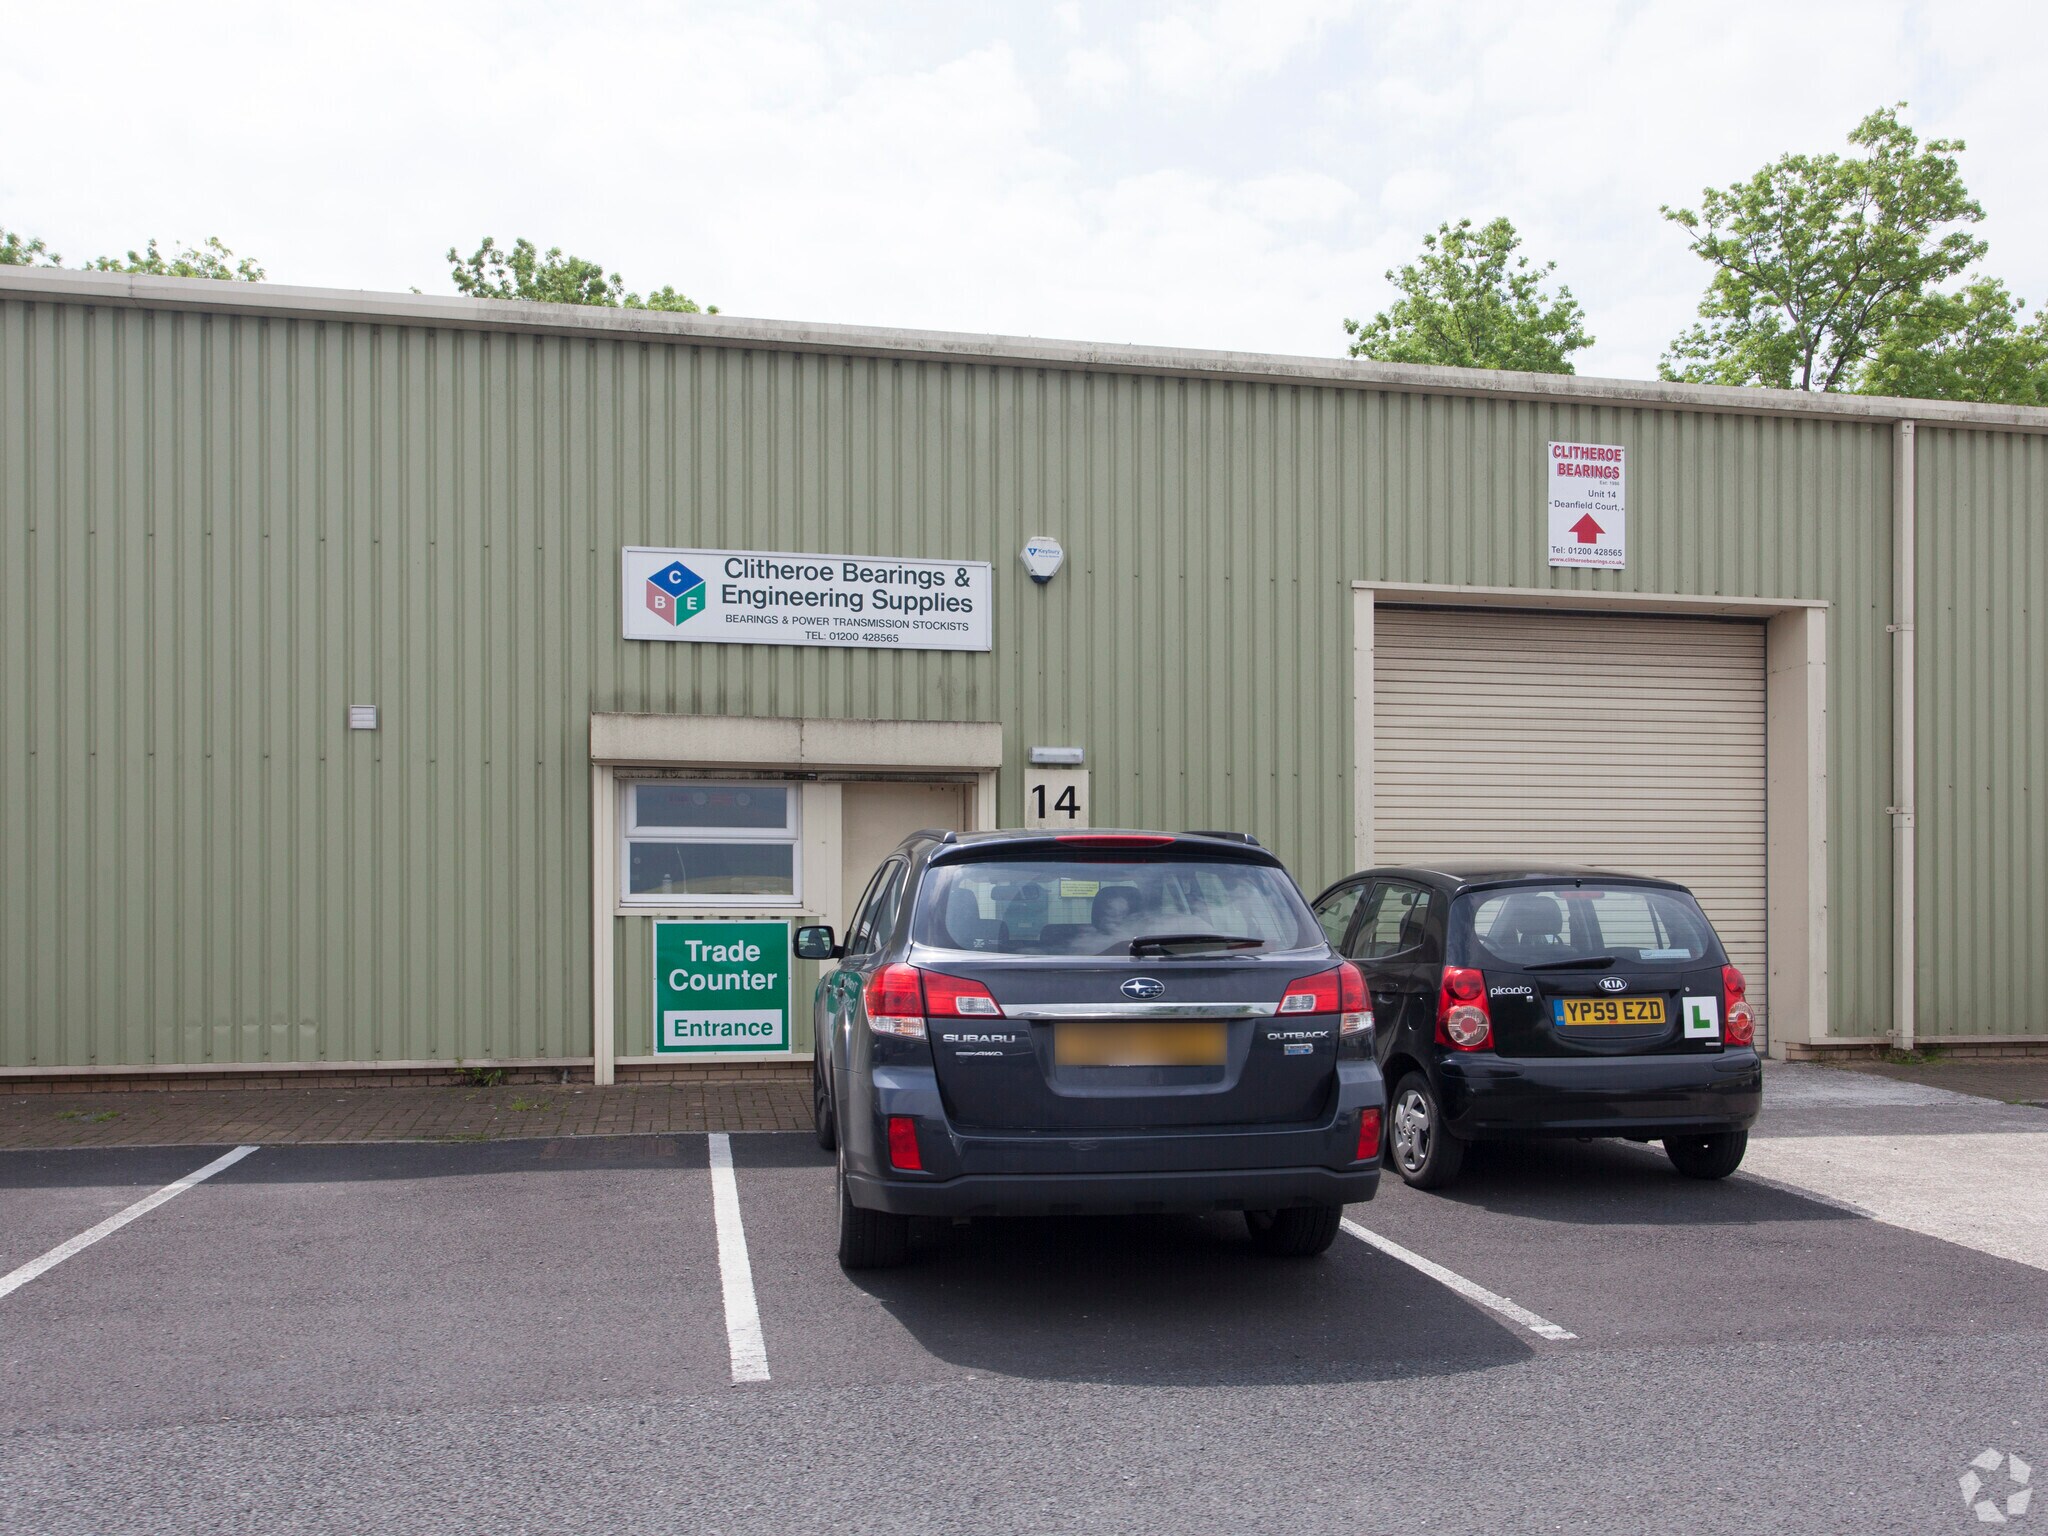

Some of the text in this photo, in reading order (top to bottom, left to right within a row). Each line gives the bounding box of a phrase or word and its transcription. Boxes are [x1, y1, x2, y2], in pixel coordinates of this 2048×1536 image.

[1552, 445, 1622, 462] CLITHEROE
[1557, 462, 1620, 480] BEARINGS
[1588, 490, 1617, 499] Unit 14
[1554, 500, 1620, 511] Deanfield Court,
[1552, 546, 1623, 557] Tel: 01200 428565
[668, 570, 682, 584] C
[724, 557, 970, 589] Clitheroe Bearings &
[654, 595, 698, 610] B E
[722, 584, 973, 616] Engineering Supplies
[725, 614, 969, 631] BEARINGS & POWER TRANSMISSION STOCKISTS
[805, 631, 899, 643] TEL: 01200 428565
[1031, 784, 1081, 819] 14
[685, 940, 761, 962] Trade
[669, 968, 778, 991] Counter
[1604, 980, 1623, 988] KIA
[1490, 986, 1532, 998] picanto
[1566, 1001, 1661, 1021] YP59 EZD
[1692, 1005, 1711, 1029] L
[674, 1019, 773, 1037] Entrance
[1267, 1030, 1329, 1040] OUTBACK
[942, 1034, 1016, 1043] SUBARU
